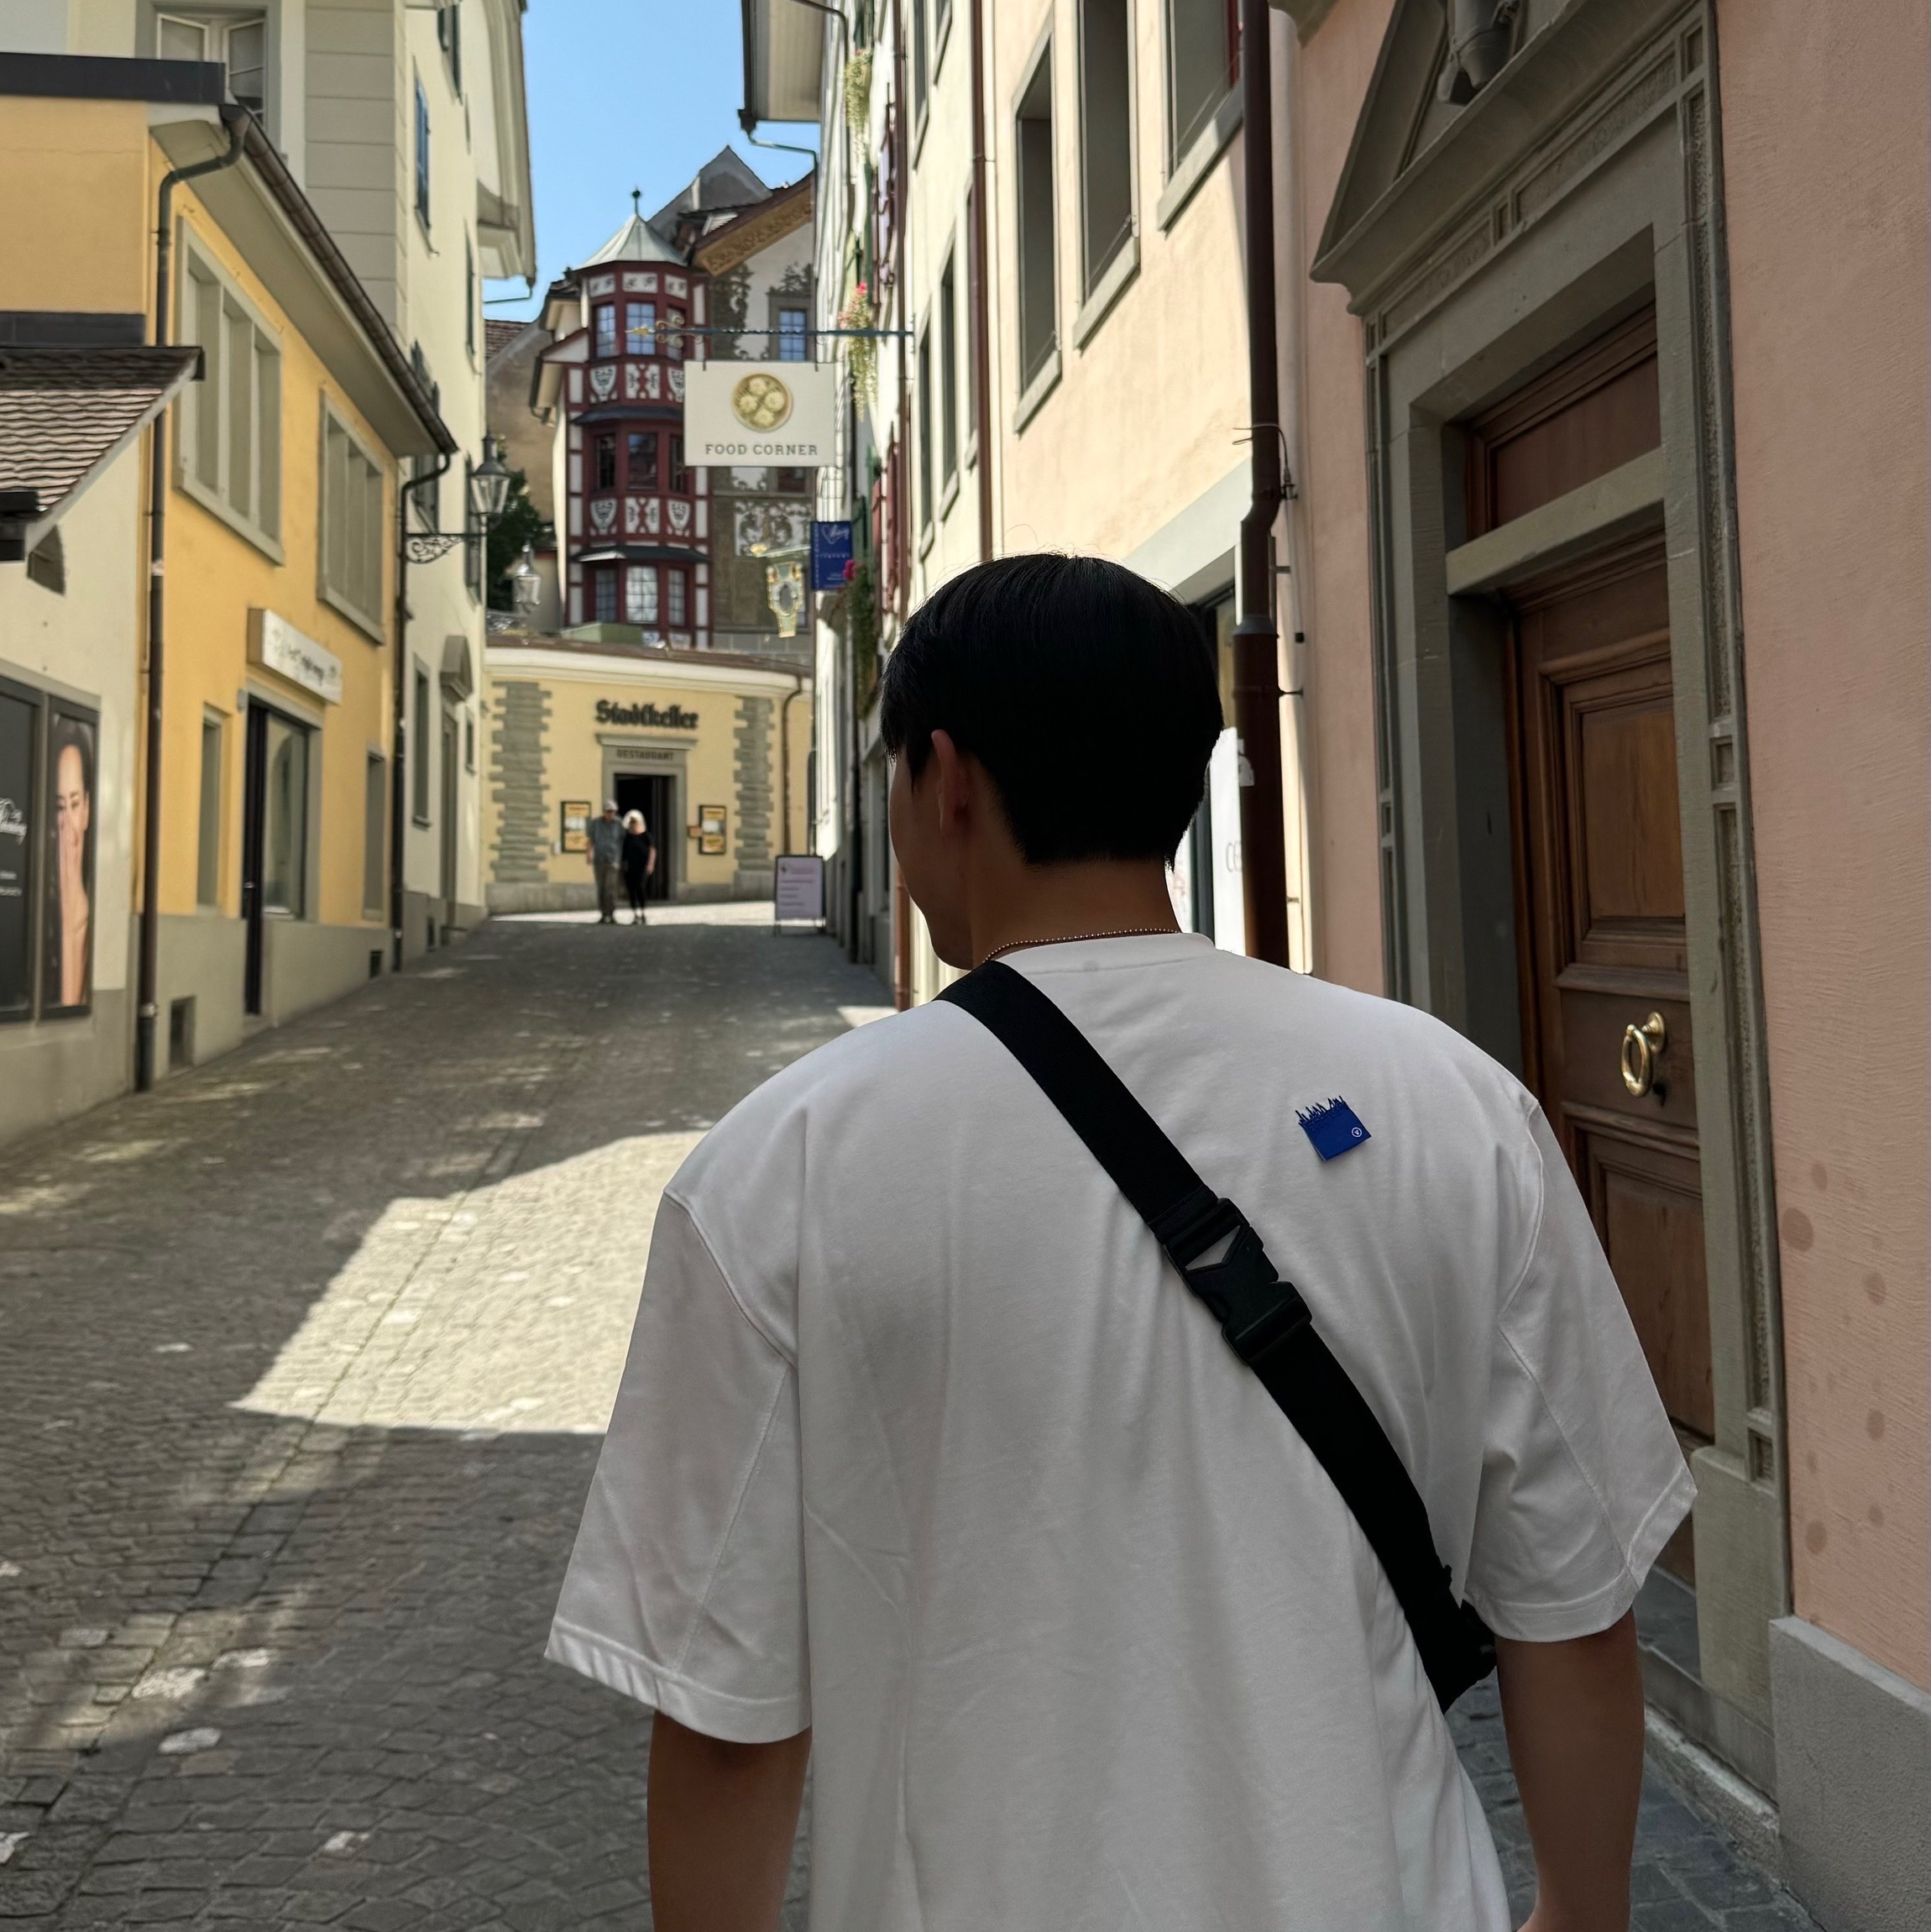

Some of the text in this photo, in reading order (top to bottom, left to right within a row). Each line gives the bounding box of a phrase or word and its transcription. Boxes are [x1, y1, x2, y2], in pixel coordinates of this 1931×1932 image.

[705, 443, 818, 456] FOOD CORNER
[596, 699, 699, 729] Stadtkeller
[616, 749, 673, 761] RESTAURANT
